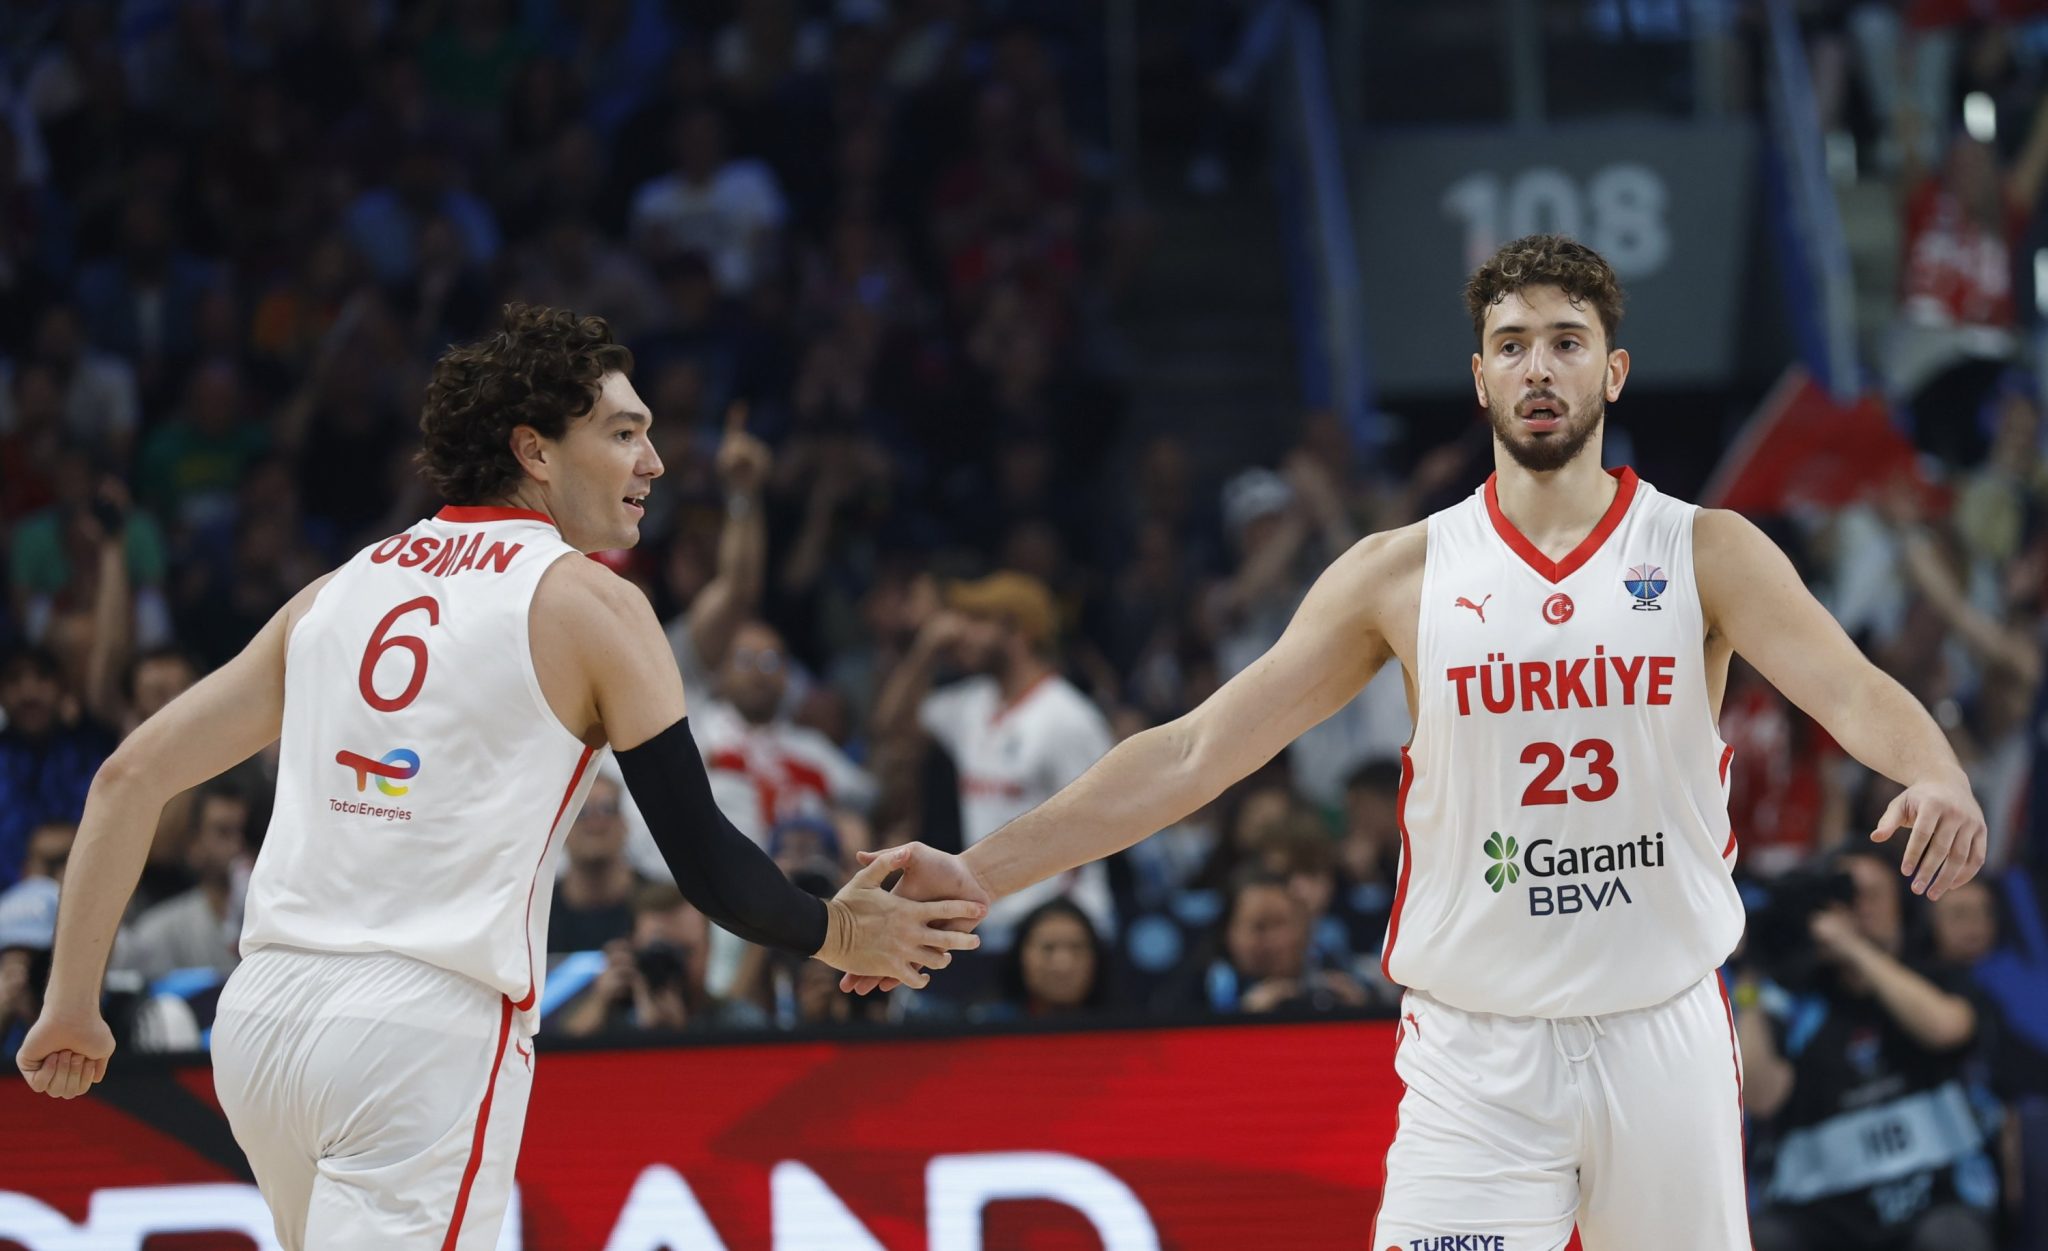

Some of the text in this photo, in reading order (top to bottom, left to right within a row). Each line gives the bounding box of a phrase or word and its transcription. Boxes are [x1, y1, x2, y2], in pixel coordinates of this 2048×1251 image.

[1443, 165, 1672, 276] 108
[371, 532, 525, 577] OSMAN
[359, 595, 440, 713] 6
[1446, 644, 1676, 716] TÜRKİYE
[1519, 738, 1619, 807] 23
[329, 798, 412, 821] TotalEnergies
[1523, 831, 1664, 878] Garanti
[1529, 876, 1632, 916] BBVA
